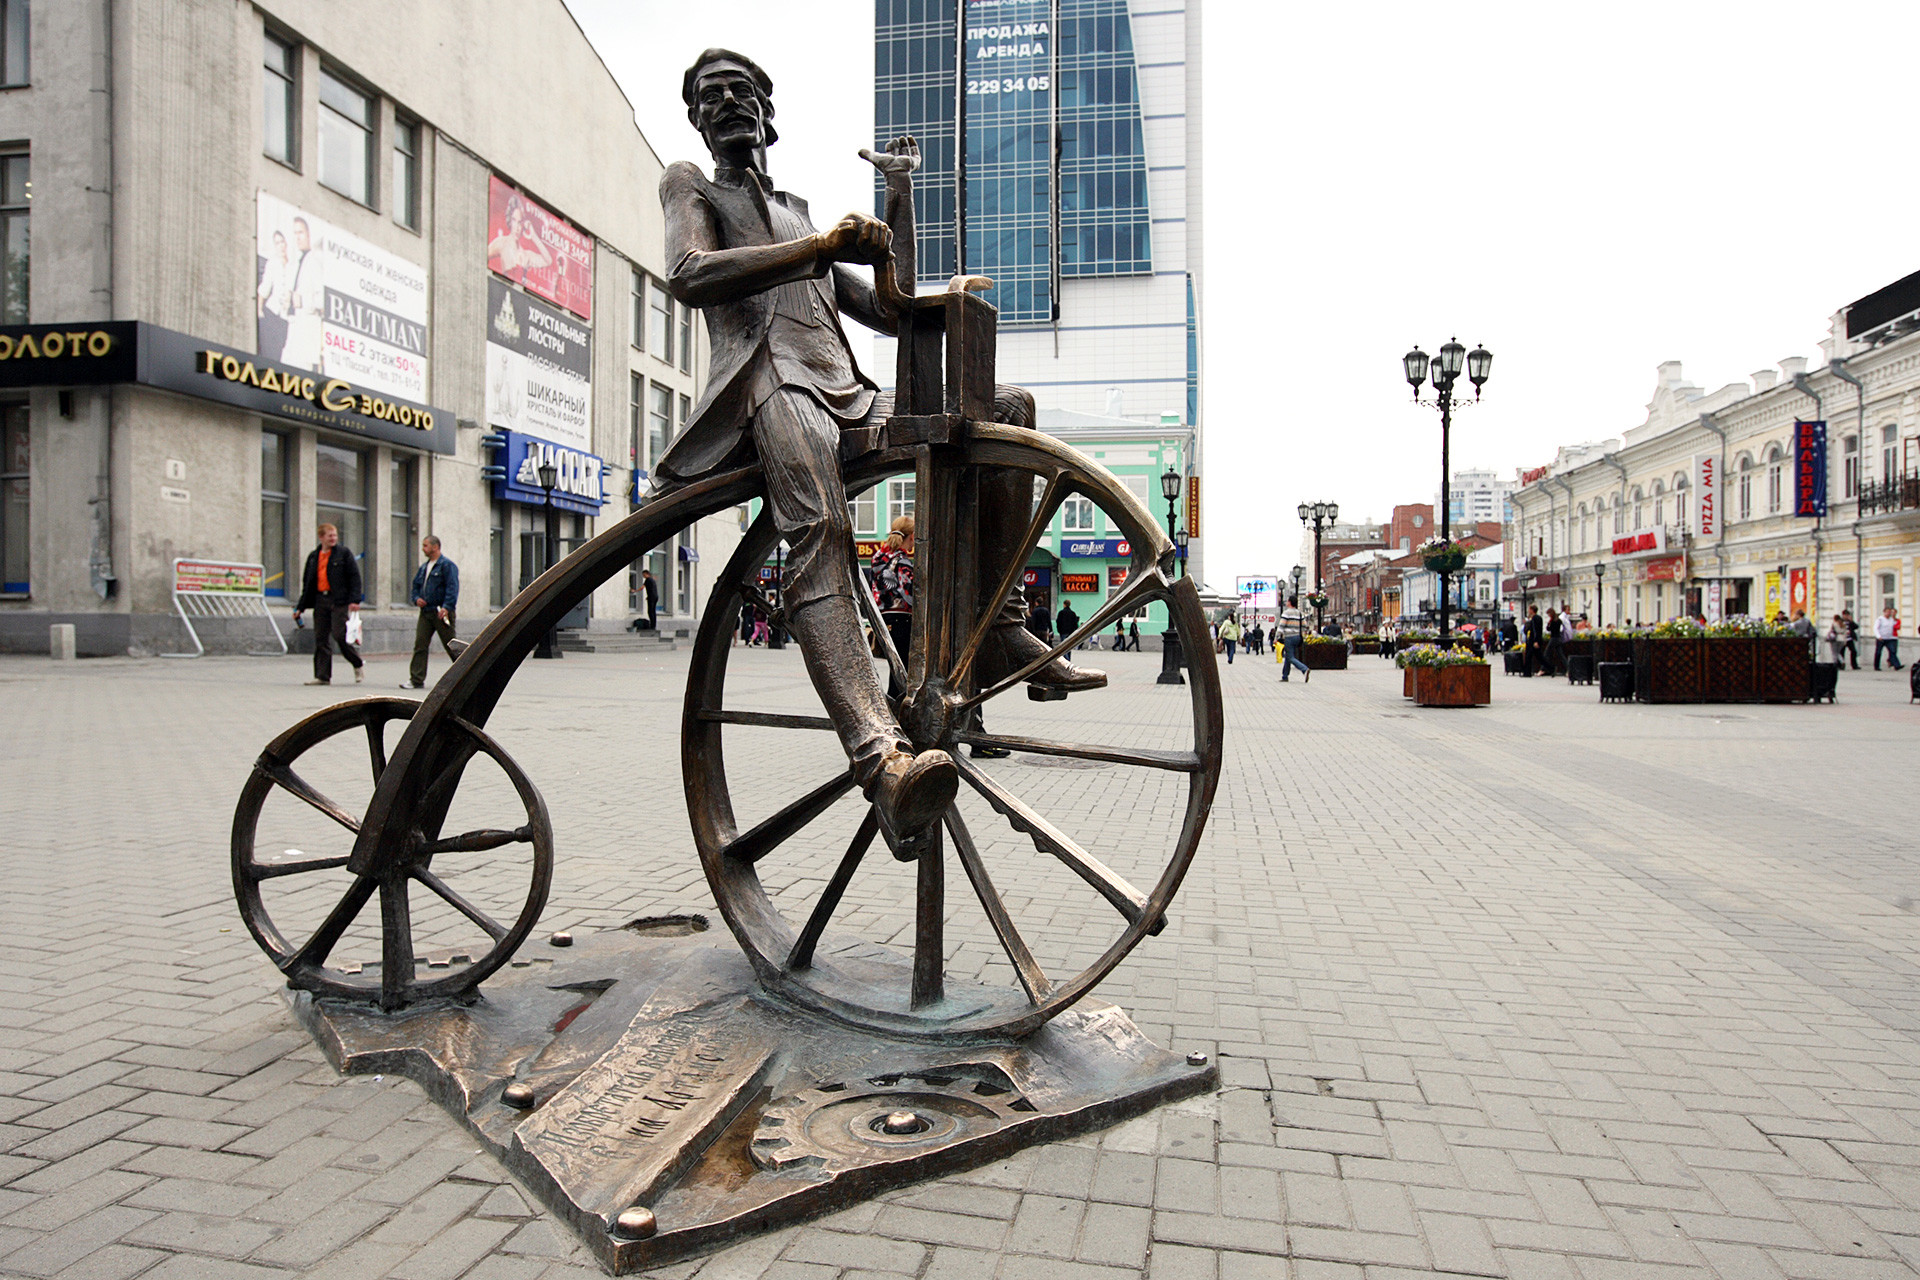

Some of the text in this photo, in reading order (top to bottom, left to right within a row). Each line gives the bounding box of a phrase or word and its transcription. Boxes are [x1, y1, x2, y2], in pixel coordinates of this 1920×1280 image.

[967, 22, 1049, 40] ПРОДАЖА
[976, 42, 1045, 59] АРЕНДА
[967, 76, 1049, 95] 229 34 05
[541, 225, 590, 266] НОВАЯ ЗАРЯ
[328, 239, 424, 294] мужская и женская
[358, 278, 398, 304] одежда
[328, 293, 423, 353] BALTMAN
[528, 306, 587, 347] ХРУСТАЛЬНЫЕ
[325, 331, 356, 354] SALE
[359, 342, 365, 357] 2
[370, 349, 396, 367] этаж
[527, 326, 565, 355] ЛЮСТРЫ
[527, 352, 561, 376] ПАССАЖ
[206, 349, 434, 431] ГОЛДИС ЗОЛОТО
[527, 380, 586, 416] ШИКАРНЫЙ
[527, 400, 557, 420] ХРУСТАЛЬ
[562, 412, 586, 427] ФАРФОР
[1798, 424, 1815, 514] БИЛЬЯРД
[1702, 458, 1713, 535] PIZZA MIA
[1117, 543, 1130, 553] GJ
[1612, 532, 1657, 555] PIZZA MIA
[1024, 572, 1036, 583] GJ
[1066, 582, 1090, 591] КАССА
